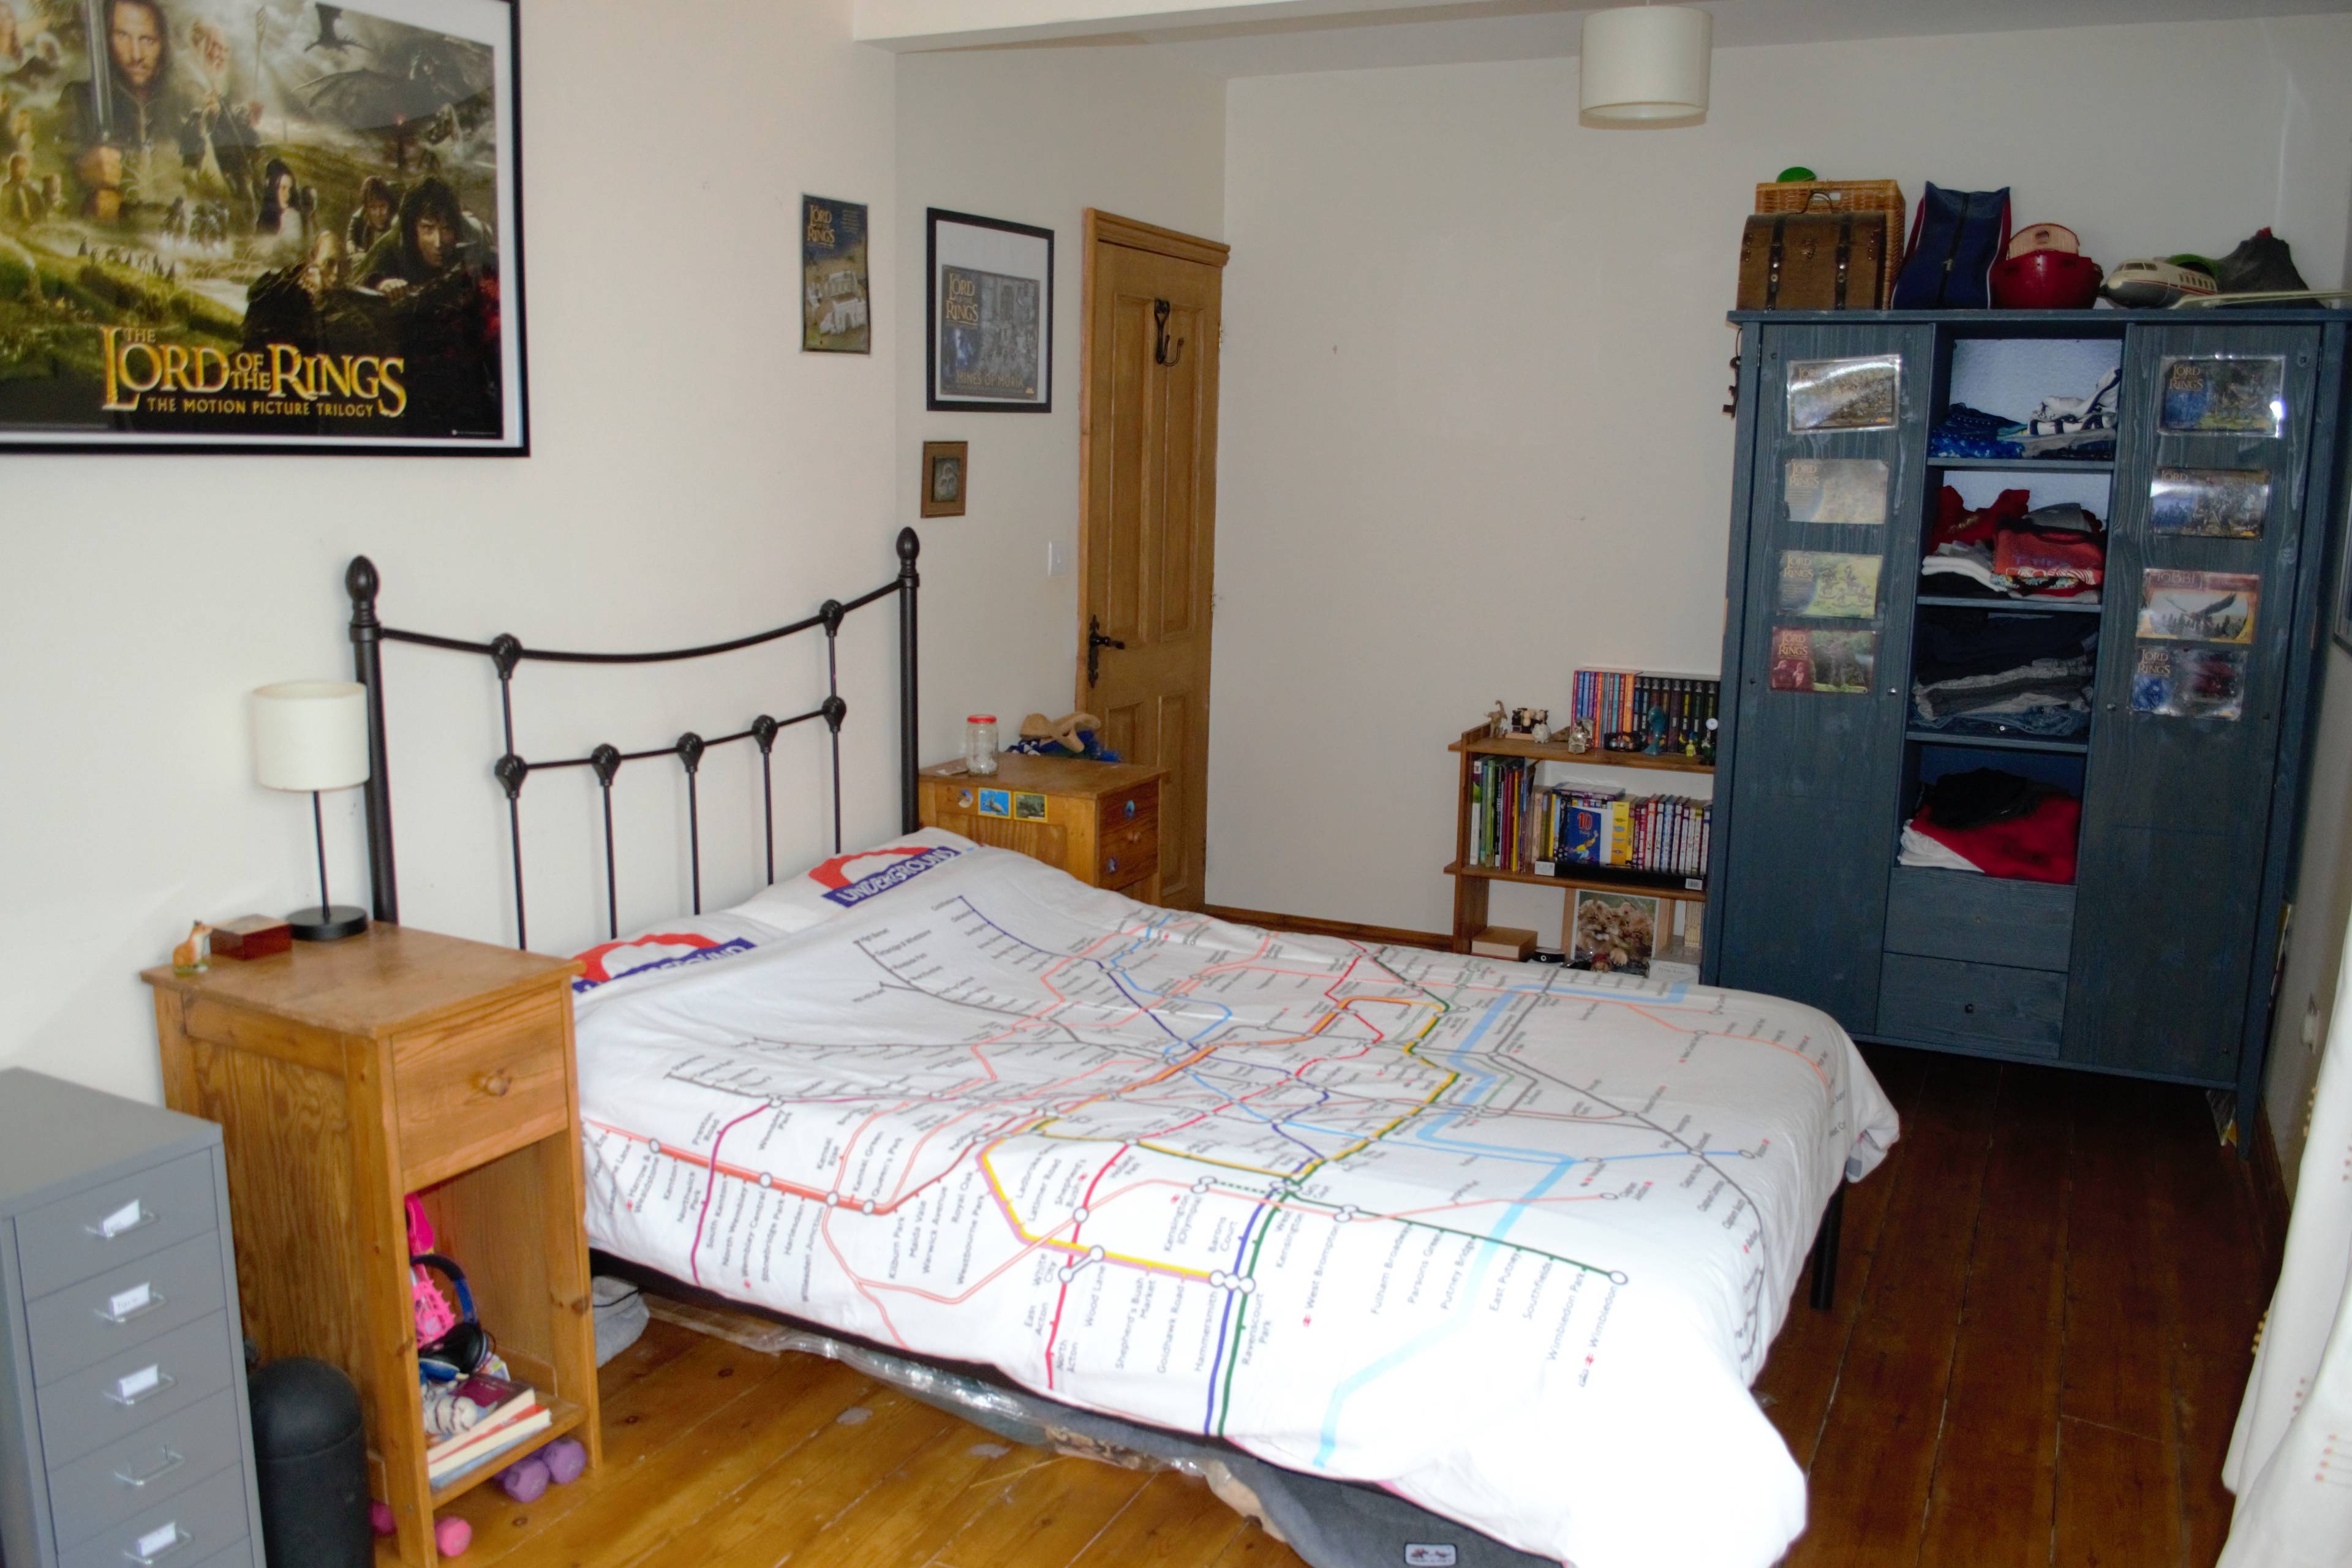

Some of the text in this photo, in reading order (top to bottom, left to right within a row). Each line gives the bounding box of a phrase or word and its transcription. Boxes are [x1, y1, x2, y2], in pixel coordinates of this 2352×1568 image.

[807, 227, 835, 244] RINGS
[950, 273, 975, 300] LORD
[946, 300, 978, 322] RINGS
[99, 326, 230, 412] LORD
[235, 352, 264, 372] OF
[229, 371, 271, 391] THE
[266, 343, 407, 418] RINGS
[146, 397, 373, 417] THE MOTION PICTURE TRILOGY
[835, 849, 956, 902] UNDERGROUND
